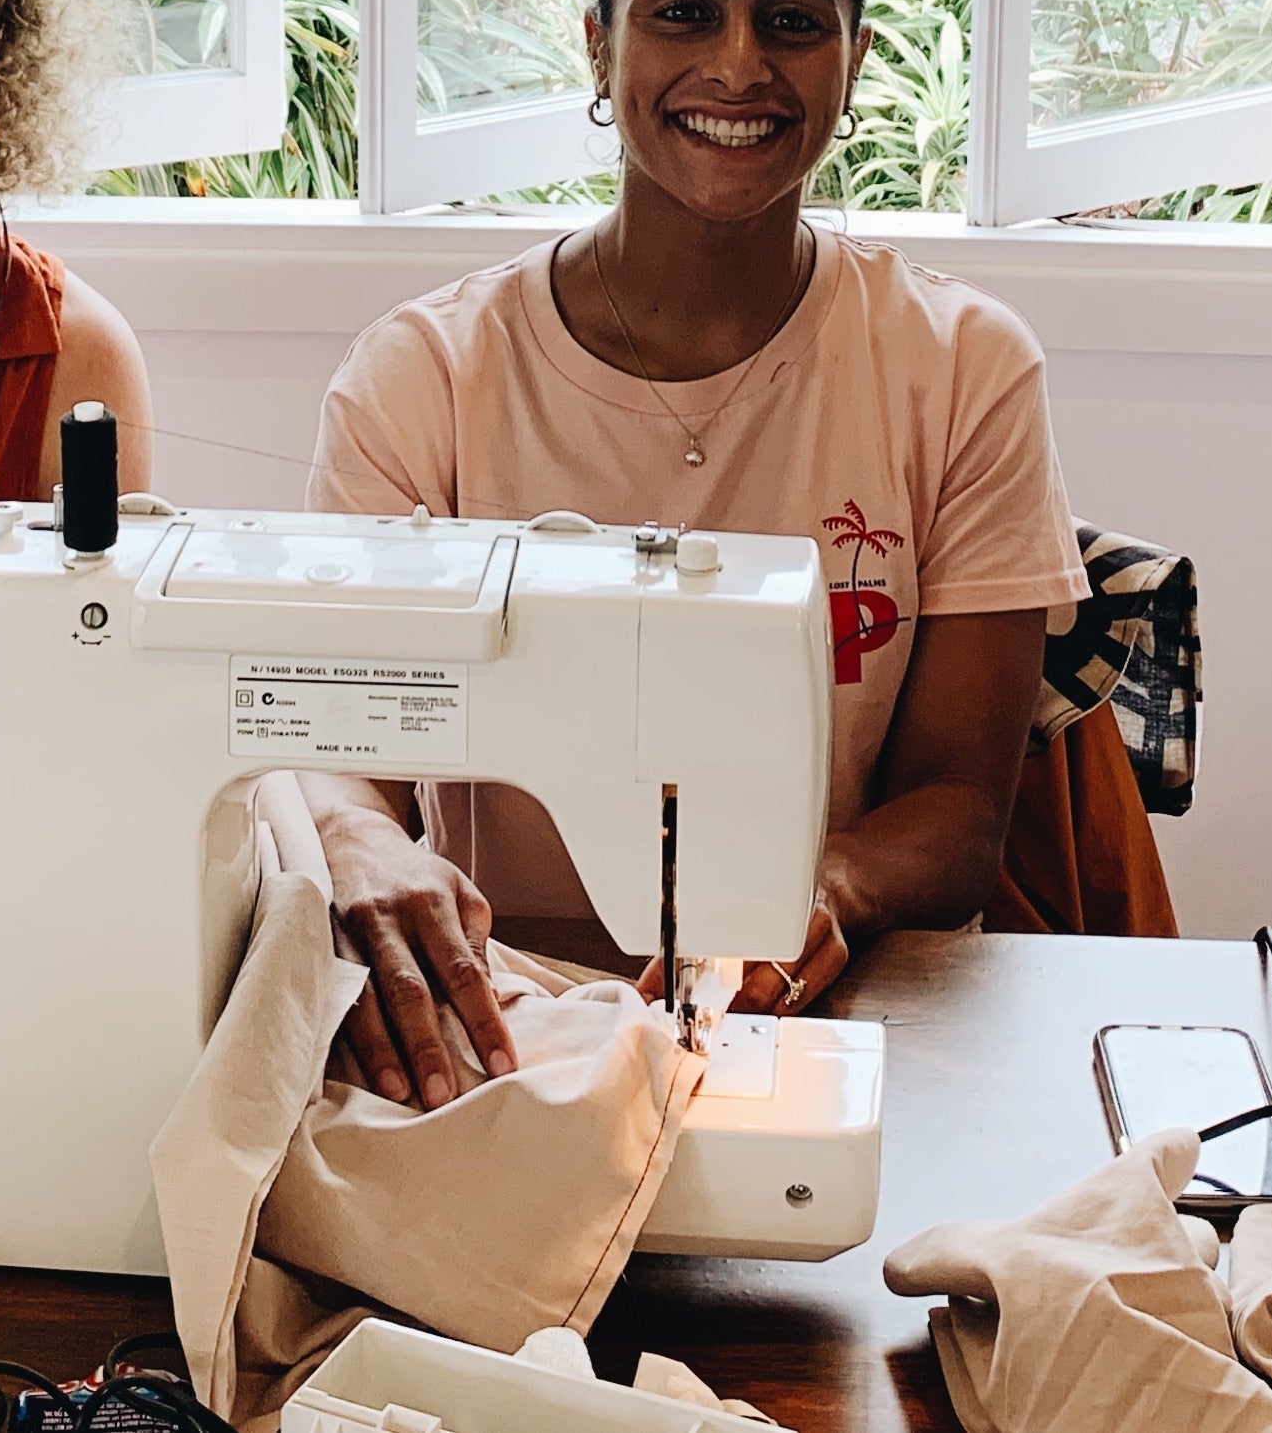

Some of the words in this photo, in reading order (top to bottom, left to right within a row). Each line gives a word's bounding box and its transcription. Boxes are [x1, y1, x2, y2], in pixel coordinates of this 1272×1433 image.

[829, 581, 849, 589] LOST
[857, 579, 886, 588] PALMS
[296, 667, 327, 675] MODEL
[373, 670, 406, 678] RS2000
[411, 671, 445, 679] SERIES
[316, 744, 339, 752] MADE
